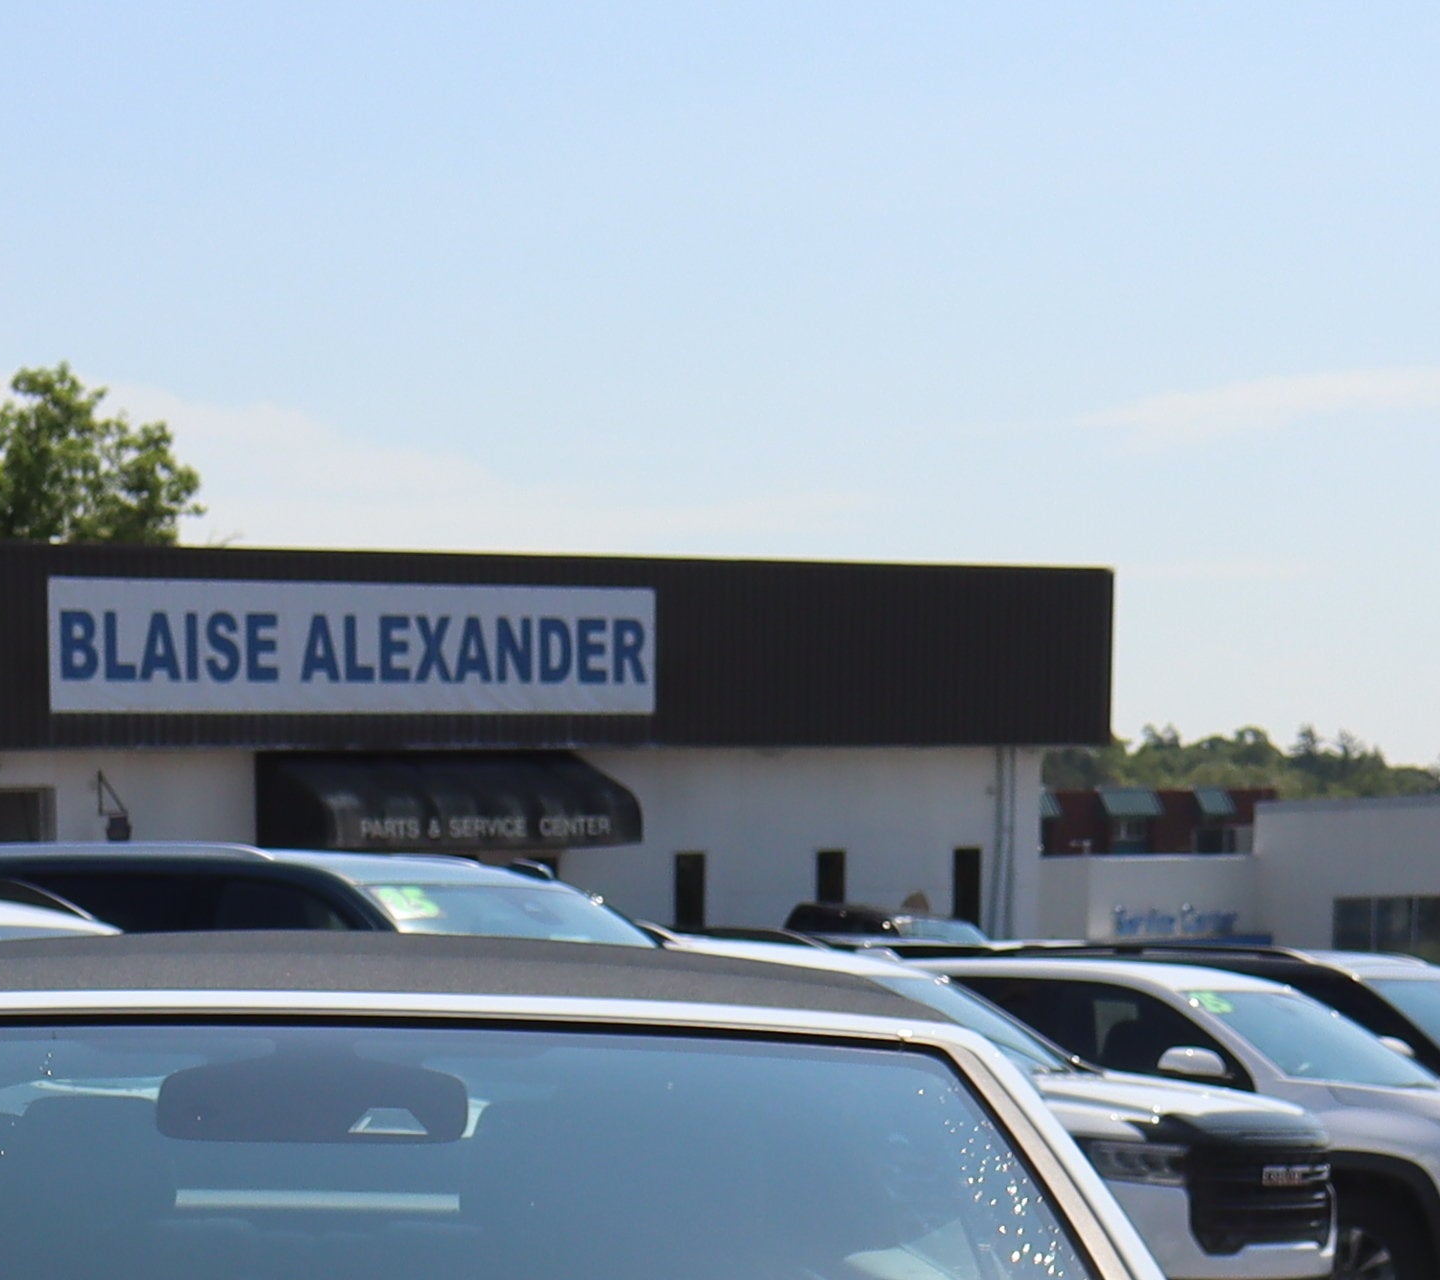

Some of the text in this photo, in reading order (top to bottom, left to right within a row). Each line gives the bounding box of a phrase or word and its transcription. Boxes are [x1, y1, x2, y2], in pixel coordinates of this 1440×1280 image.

[58, 609, 647, 685] BLAISE ALEXANDER
[359, 814, 611, 839] PARTS & SERVICE CENTER
